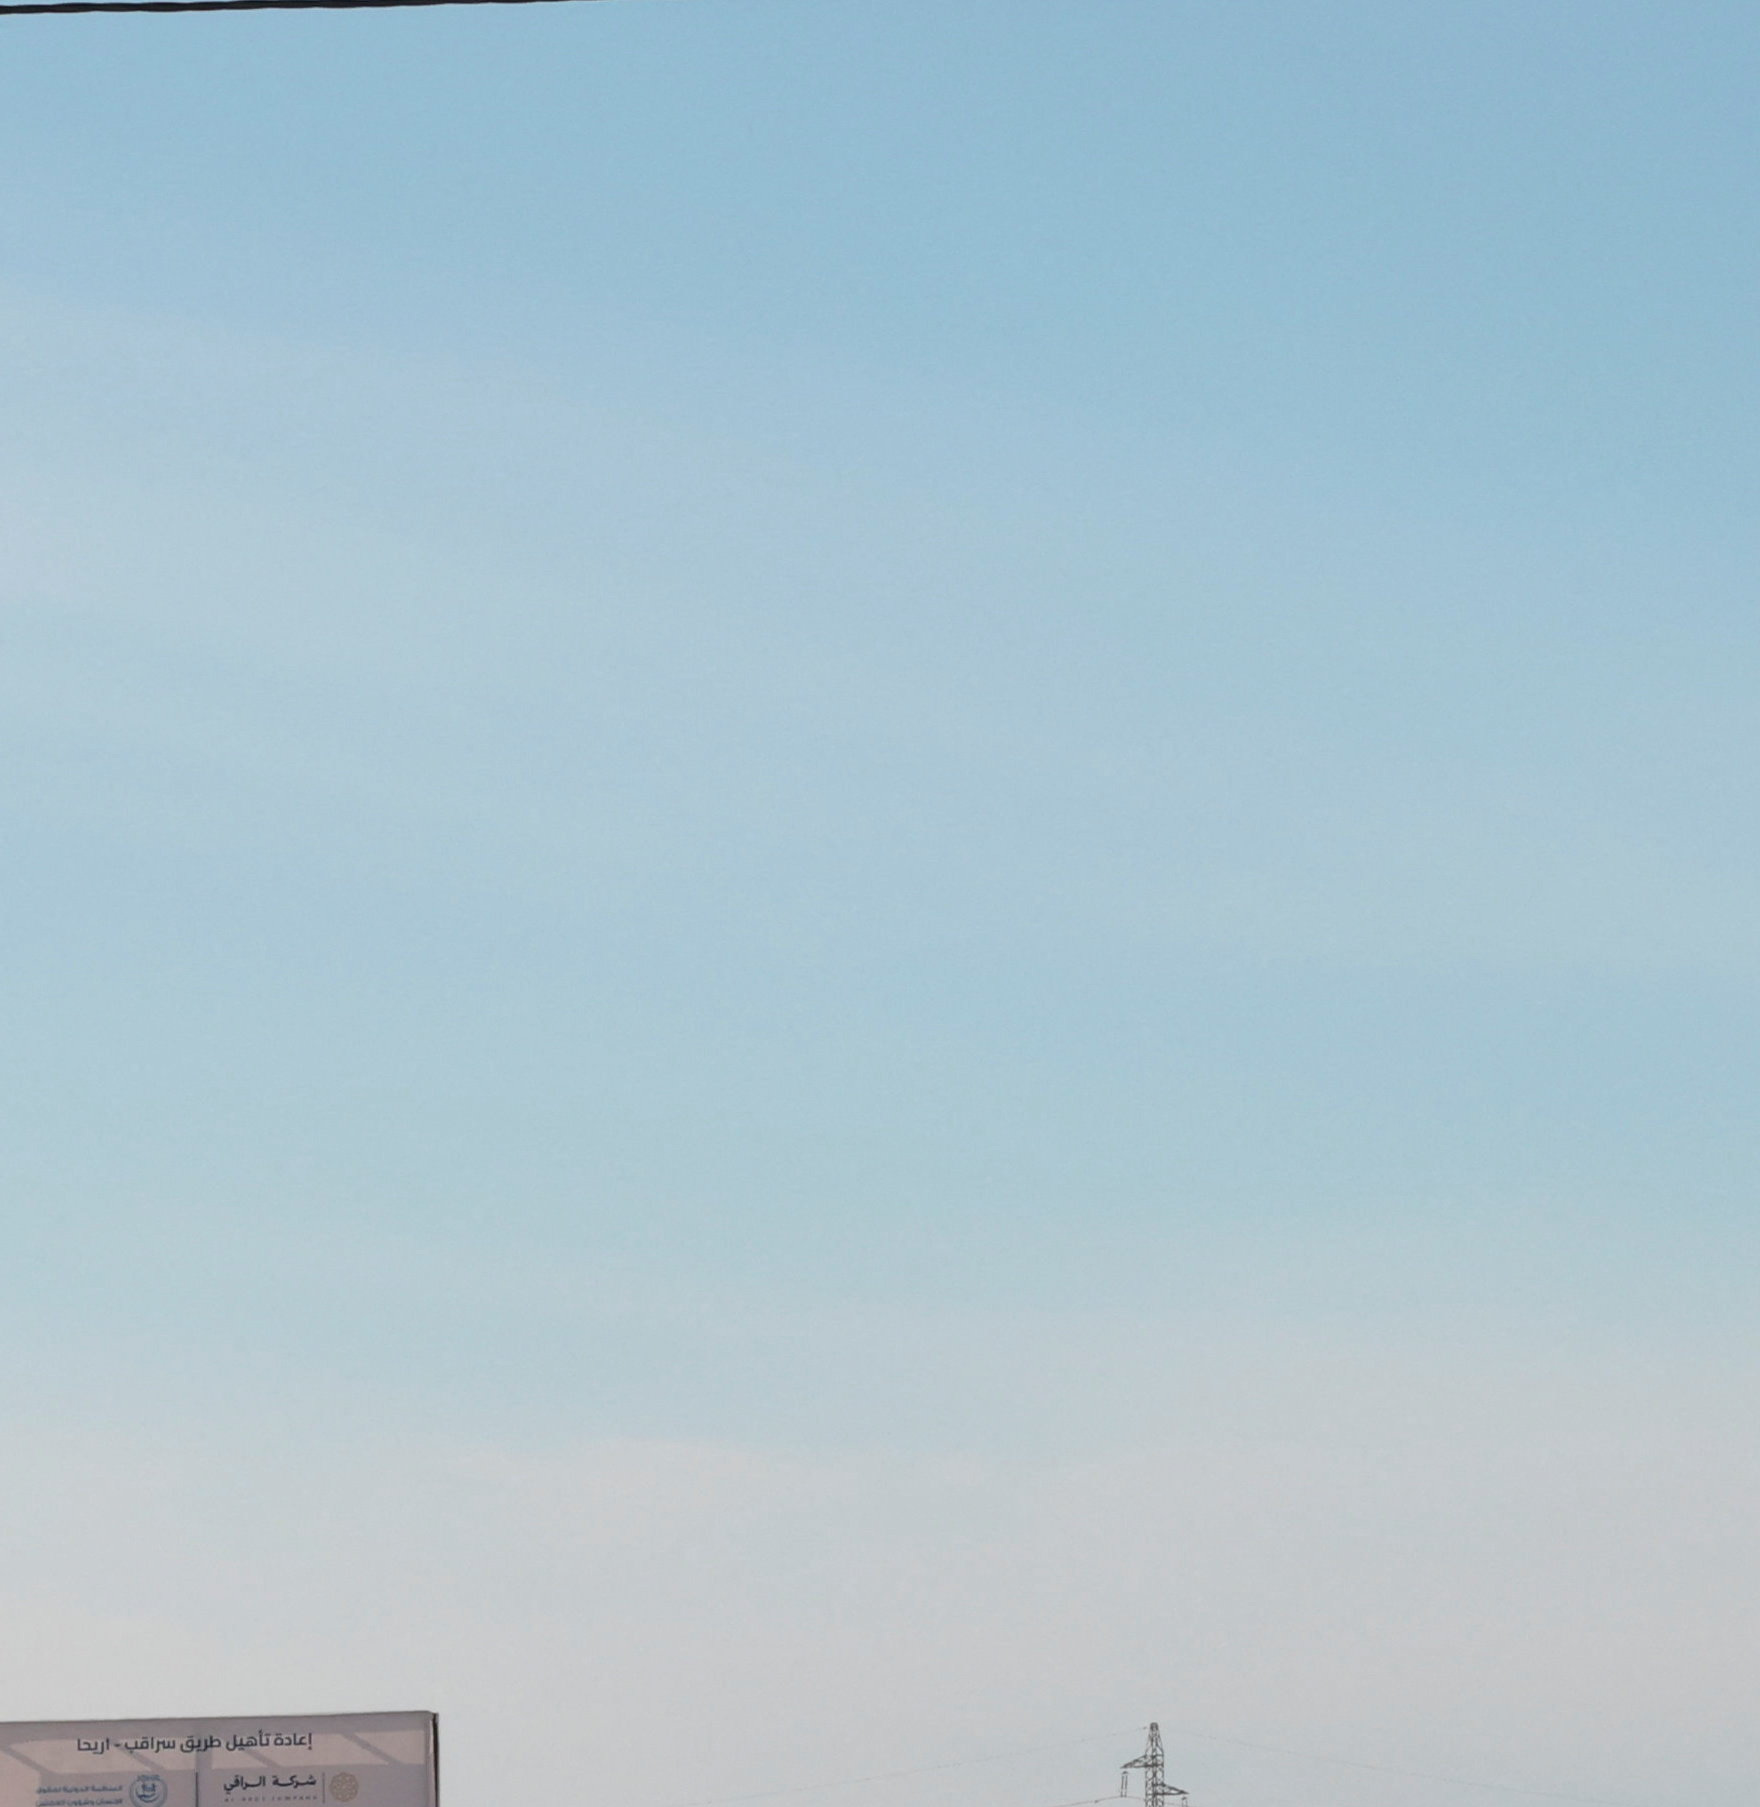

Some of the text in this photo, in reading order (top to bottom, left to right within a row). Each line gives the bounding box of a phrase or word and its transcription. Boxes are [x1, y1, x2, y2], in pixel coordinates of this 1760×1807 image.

[124, 1736, 176, 1754] سراقب
[180, 1734, 221, 1752] طريق
[225, 1729, 270, 1751] تأهيل
[273, 1732, 312, 1750] إعادة
[223, 1774, 317, 1795] شركة الراقي
